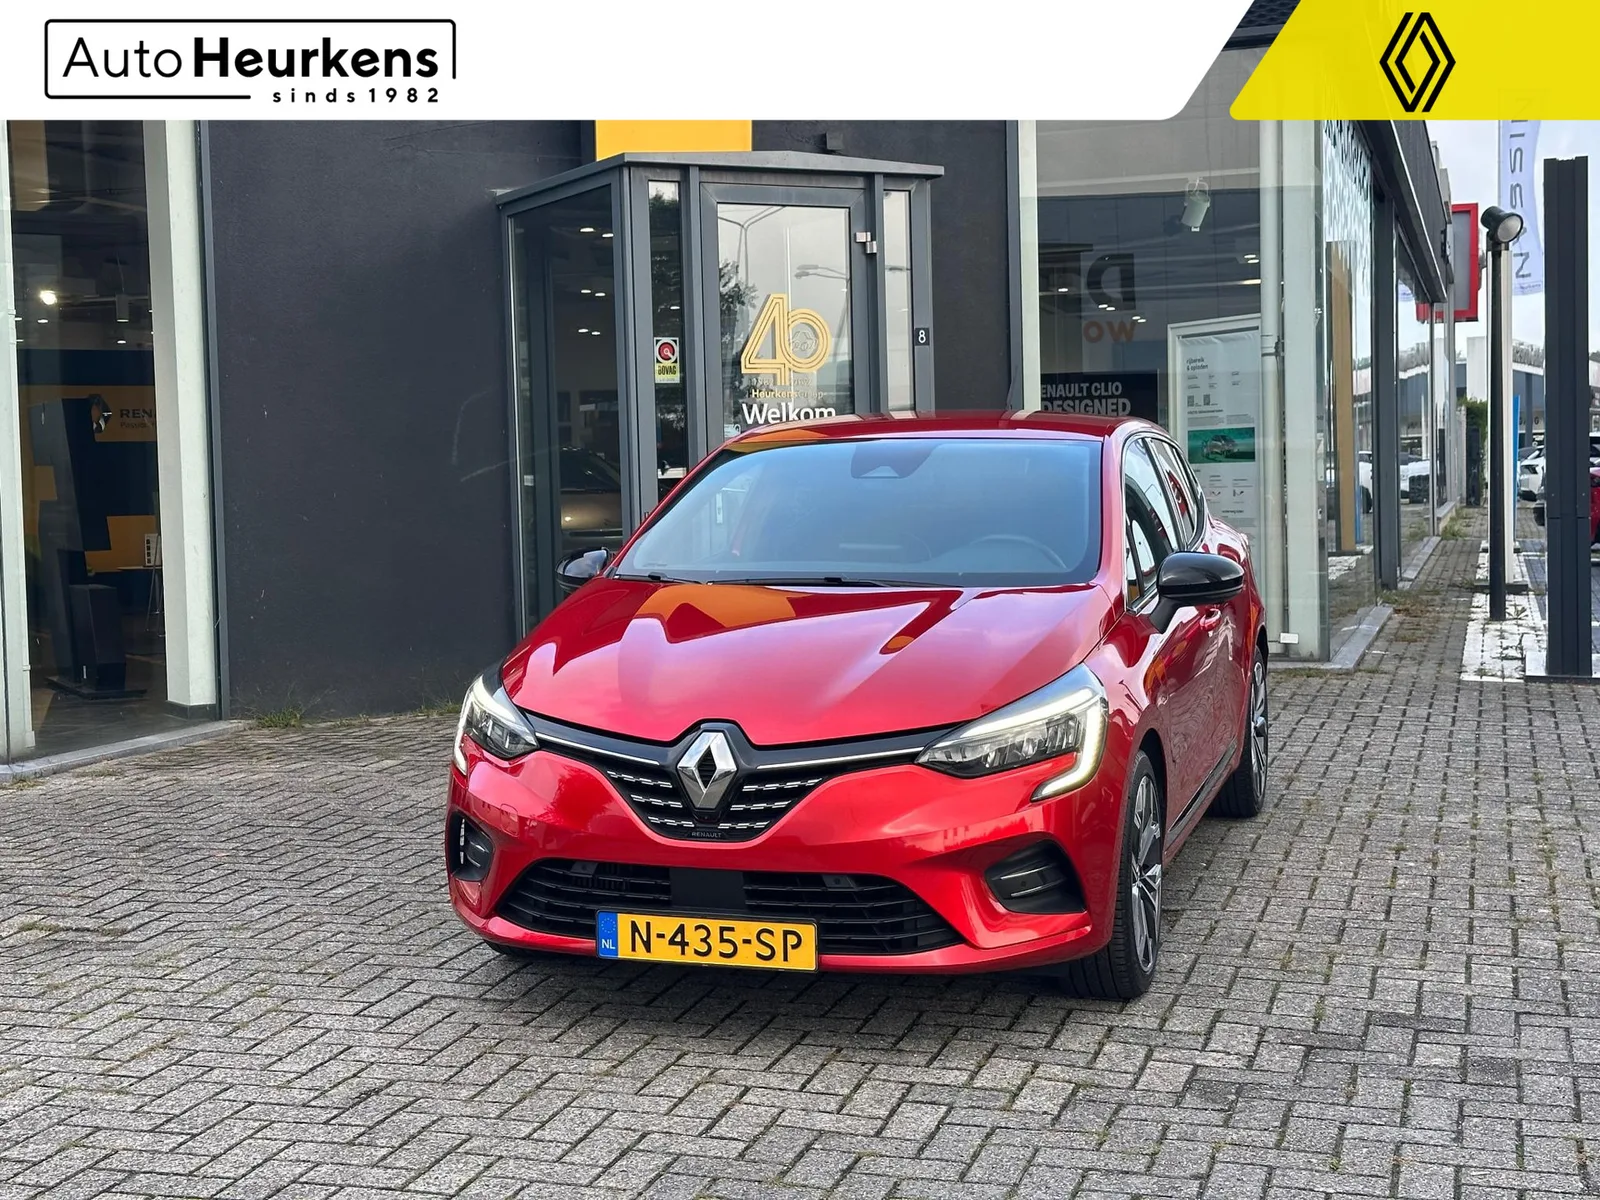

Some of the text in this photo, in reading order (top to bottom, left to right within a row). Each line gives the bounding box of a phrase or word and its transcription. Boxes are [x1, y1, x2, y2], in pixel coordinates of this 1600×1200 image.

[740, 294, 832, 386] 40
[918, 329, 926, 344] 8
[1041, 382, 1122, 398] ENAULT CLIO
[742, 402, 836, 425] Welkom
[601, 939, 615, 950] NL
[630, 920, 802, 962] N-435-SP
